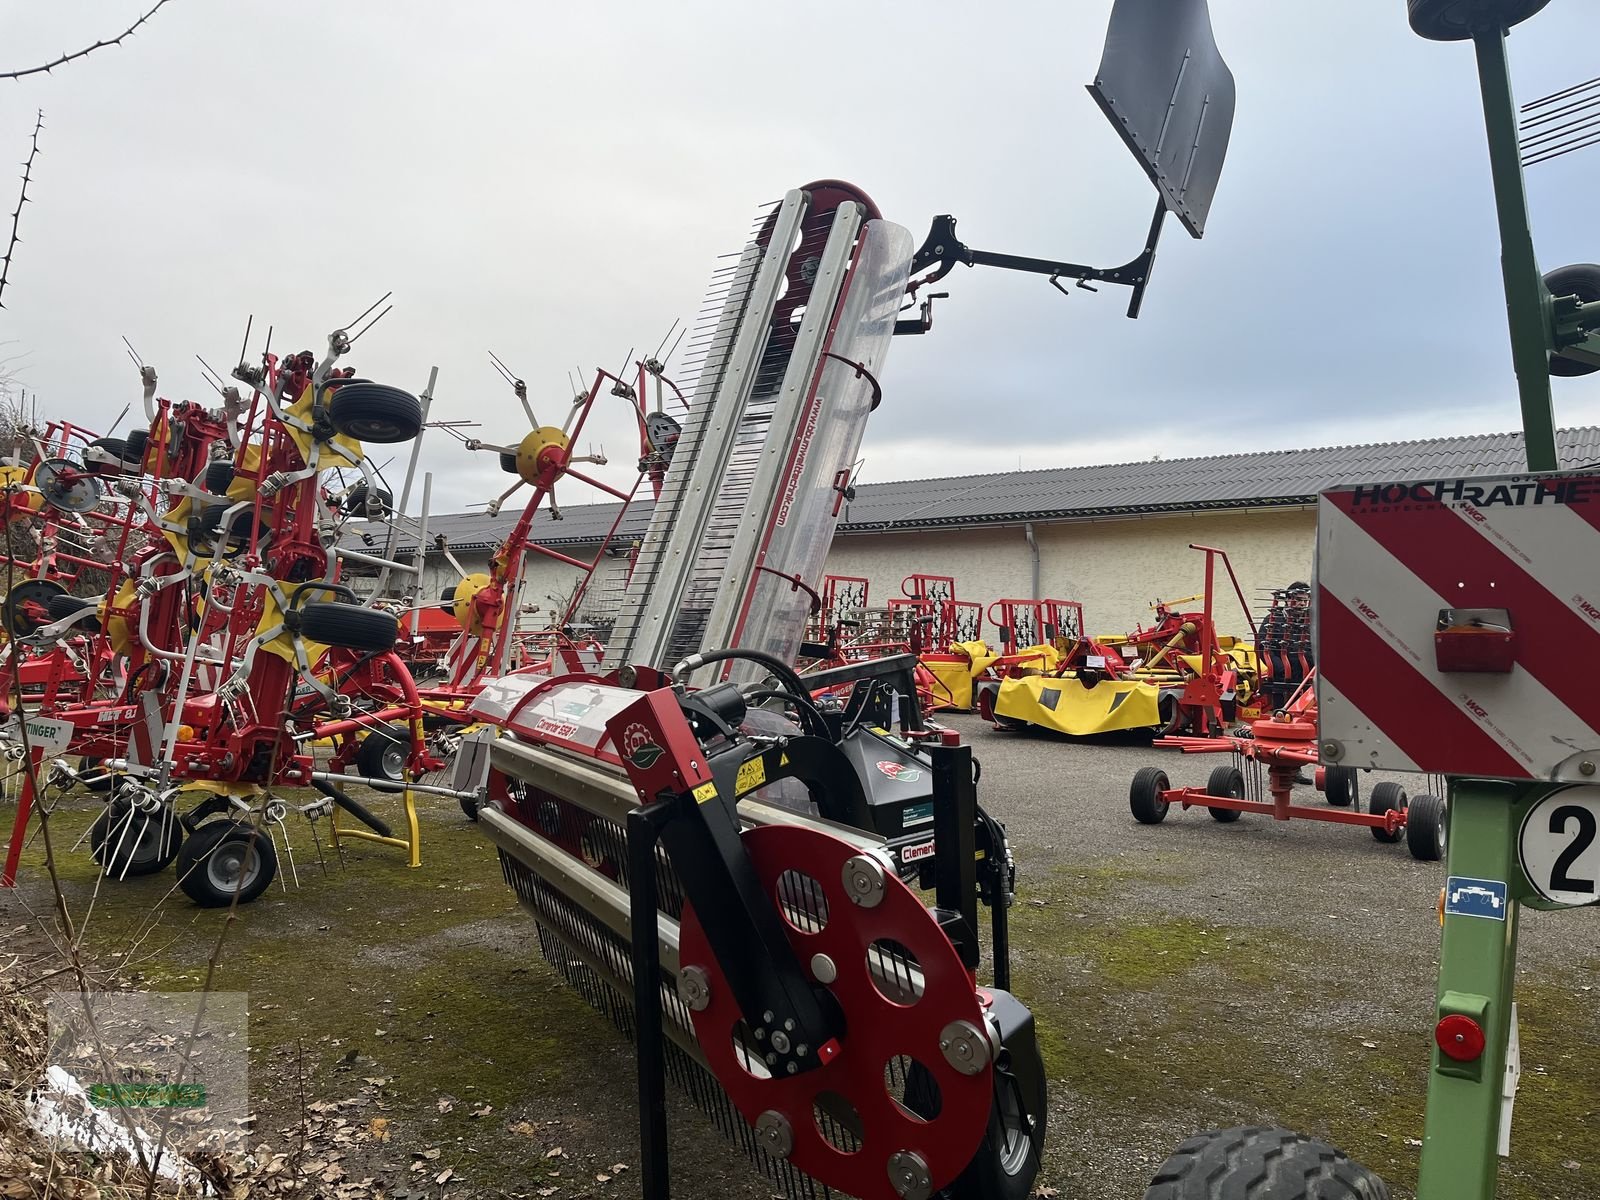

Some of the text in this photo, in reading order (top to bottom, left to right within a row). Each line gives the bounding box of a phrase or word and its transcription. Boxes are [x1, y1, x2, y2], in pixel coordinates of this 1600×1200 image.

[776, 399, 822, 526] www.bbumwelttechnik.com
[1352, 480, 1600, 507] HOCHRATHE
[1350, 502, 1466, 514] LANDTECHNIK
[1358, 603, 1380, 620] WGF
[1580, 601, 1600, 619] WG
[1466, 699, 1488, 718] WGF
[26, 722, 57, 739] TINGER
[1549, 805, 1597, 894] 2
